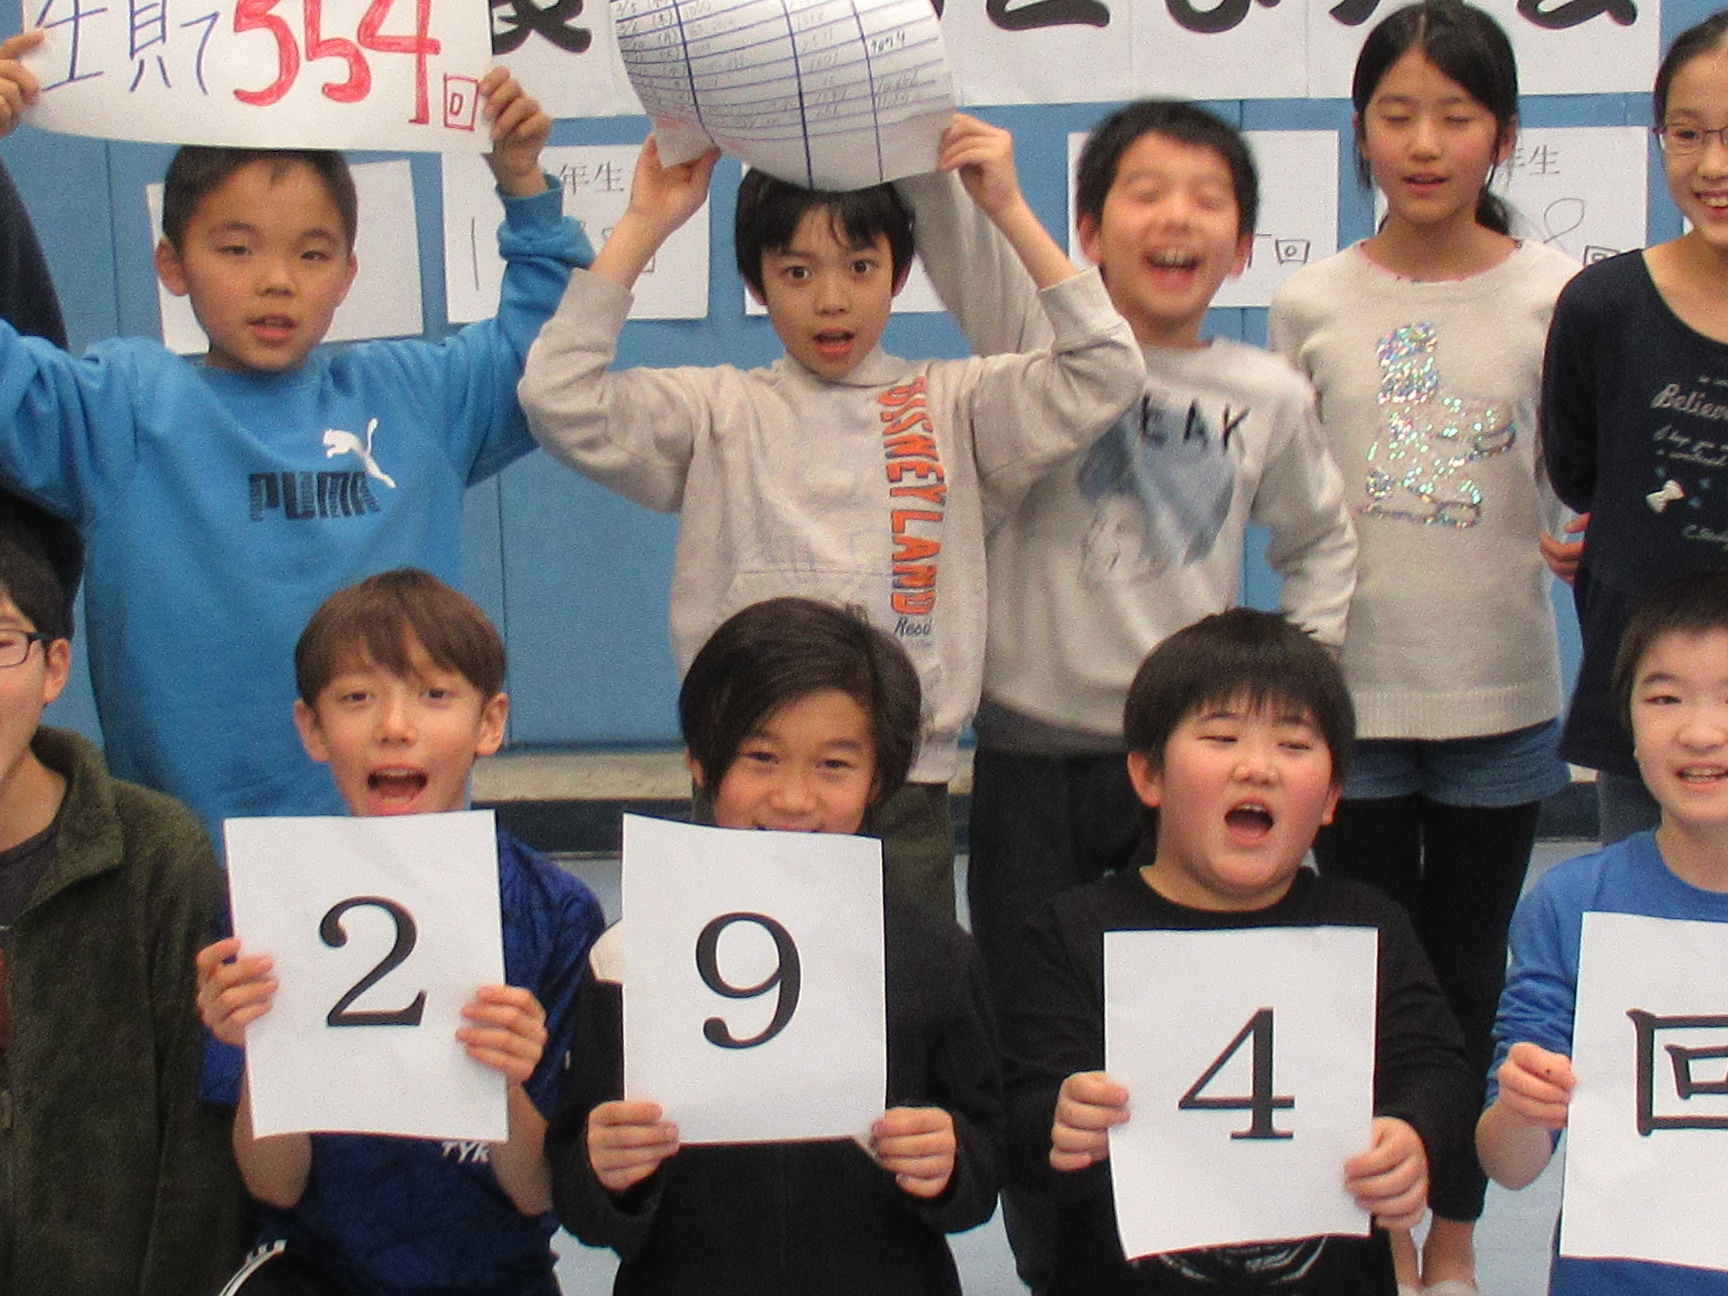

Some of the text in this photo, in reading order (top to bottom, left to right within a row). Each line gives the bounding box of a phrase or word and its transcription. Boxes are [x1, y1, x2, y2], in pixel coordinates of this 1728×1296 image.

[249, 470, 383, 522] PUMA
[317, 894, 428, 1029] 2
[695, 911, 802, 1051] 9
[1176, 1006, 1297, 1143] 4
